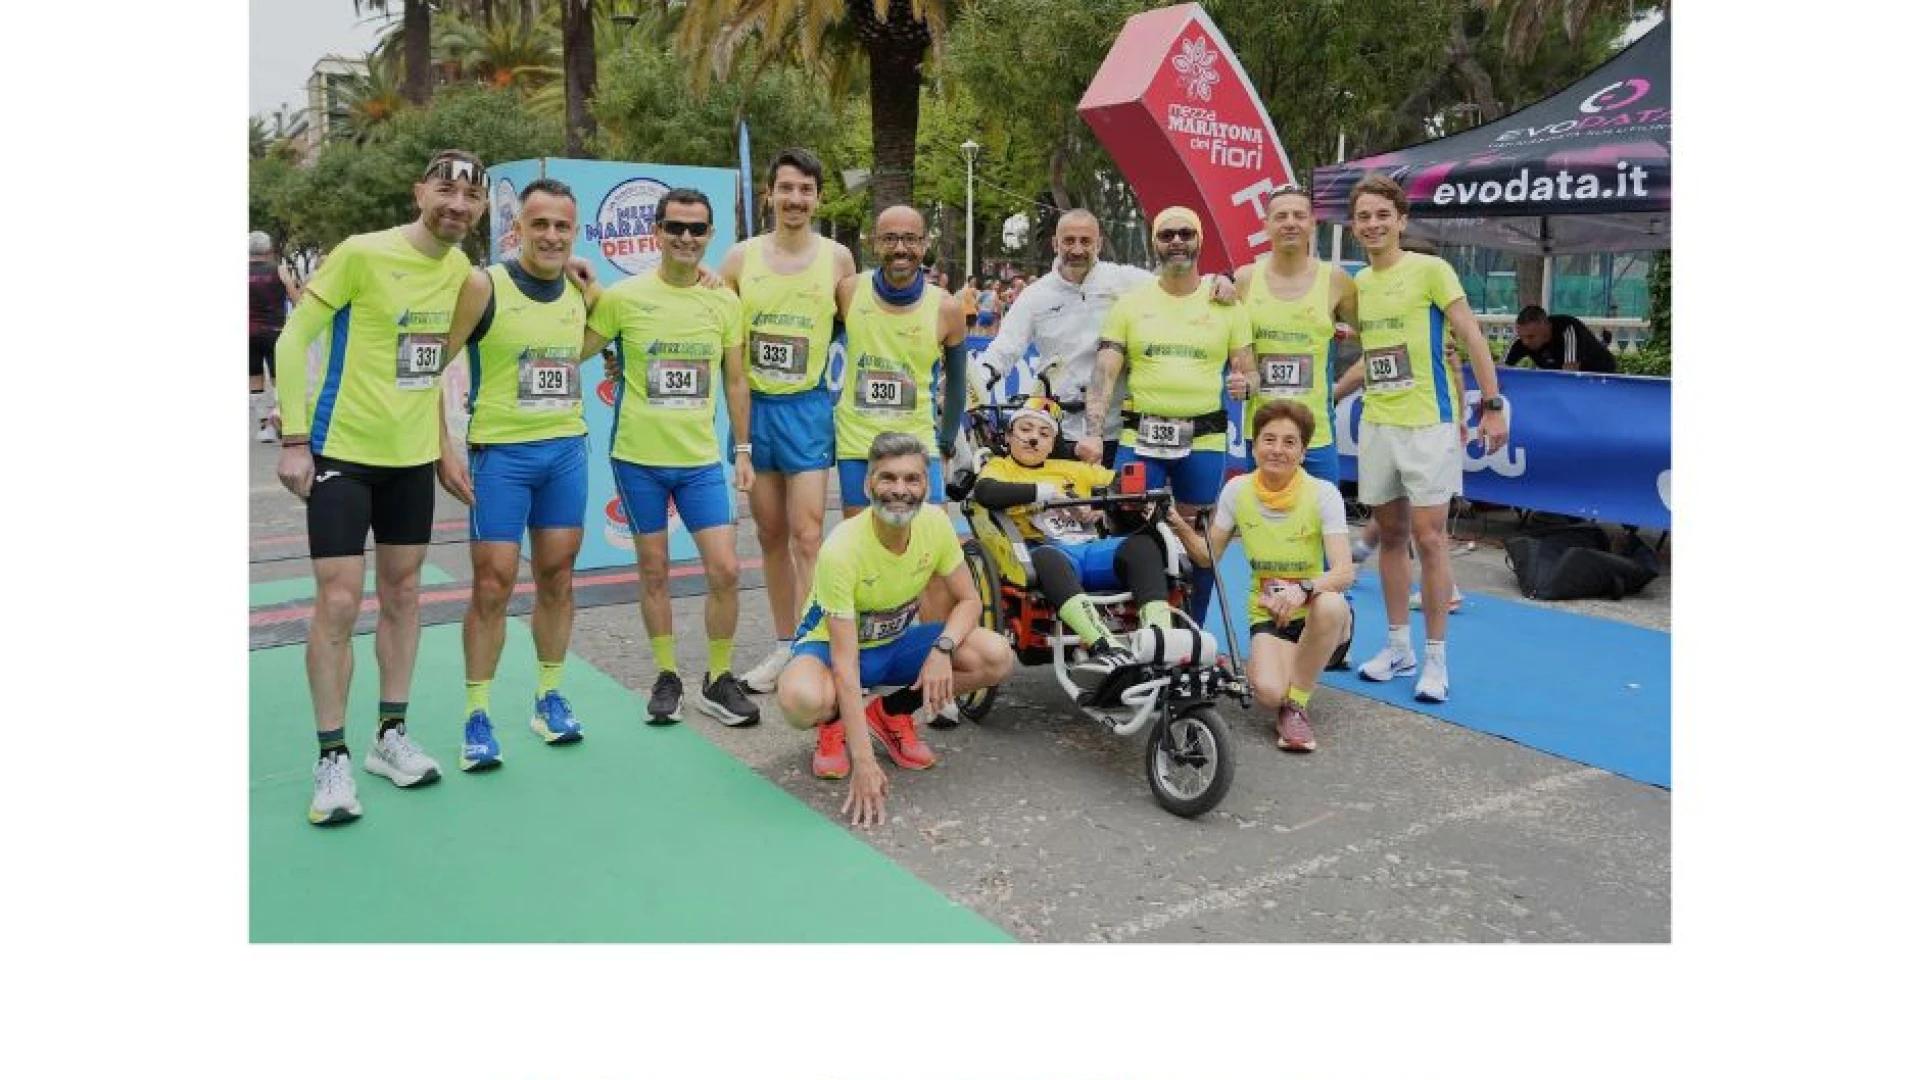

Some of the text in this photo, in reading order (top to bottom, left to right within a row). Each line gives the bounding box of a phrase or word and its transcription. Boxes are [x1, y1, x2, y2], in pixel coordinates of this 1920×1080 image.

[1168, 103, 1216, 121] mezza
[1167, 115, 1263, 144] MARATONA
[1210, 138, 1263, 171] fiori
[1433, 161, 1649, 205] evodata.it
[585, 219, 657, 241] MARAT
[602, 240, 634, 257] DEI
[416, 346, 437, 366] 331
[763, 344, 788, 364] 333
[538, 370, 563, 389] 329
[665, 370, 692, 389] 334
[1271, 364, 1294, 379] 337
[871, 382, 896, 400] 330
